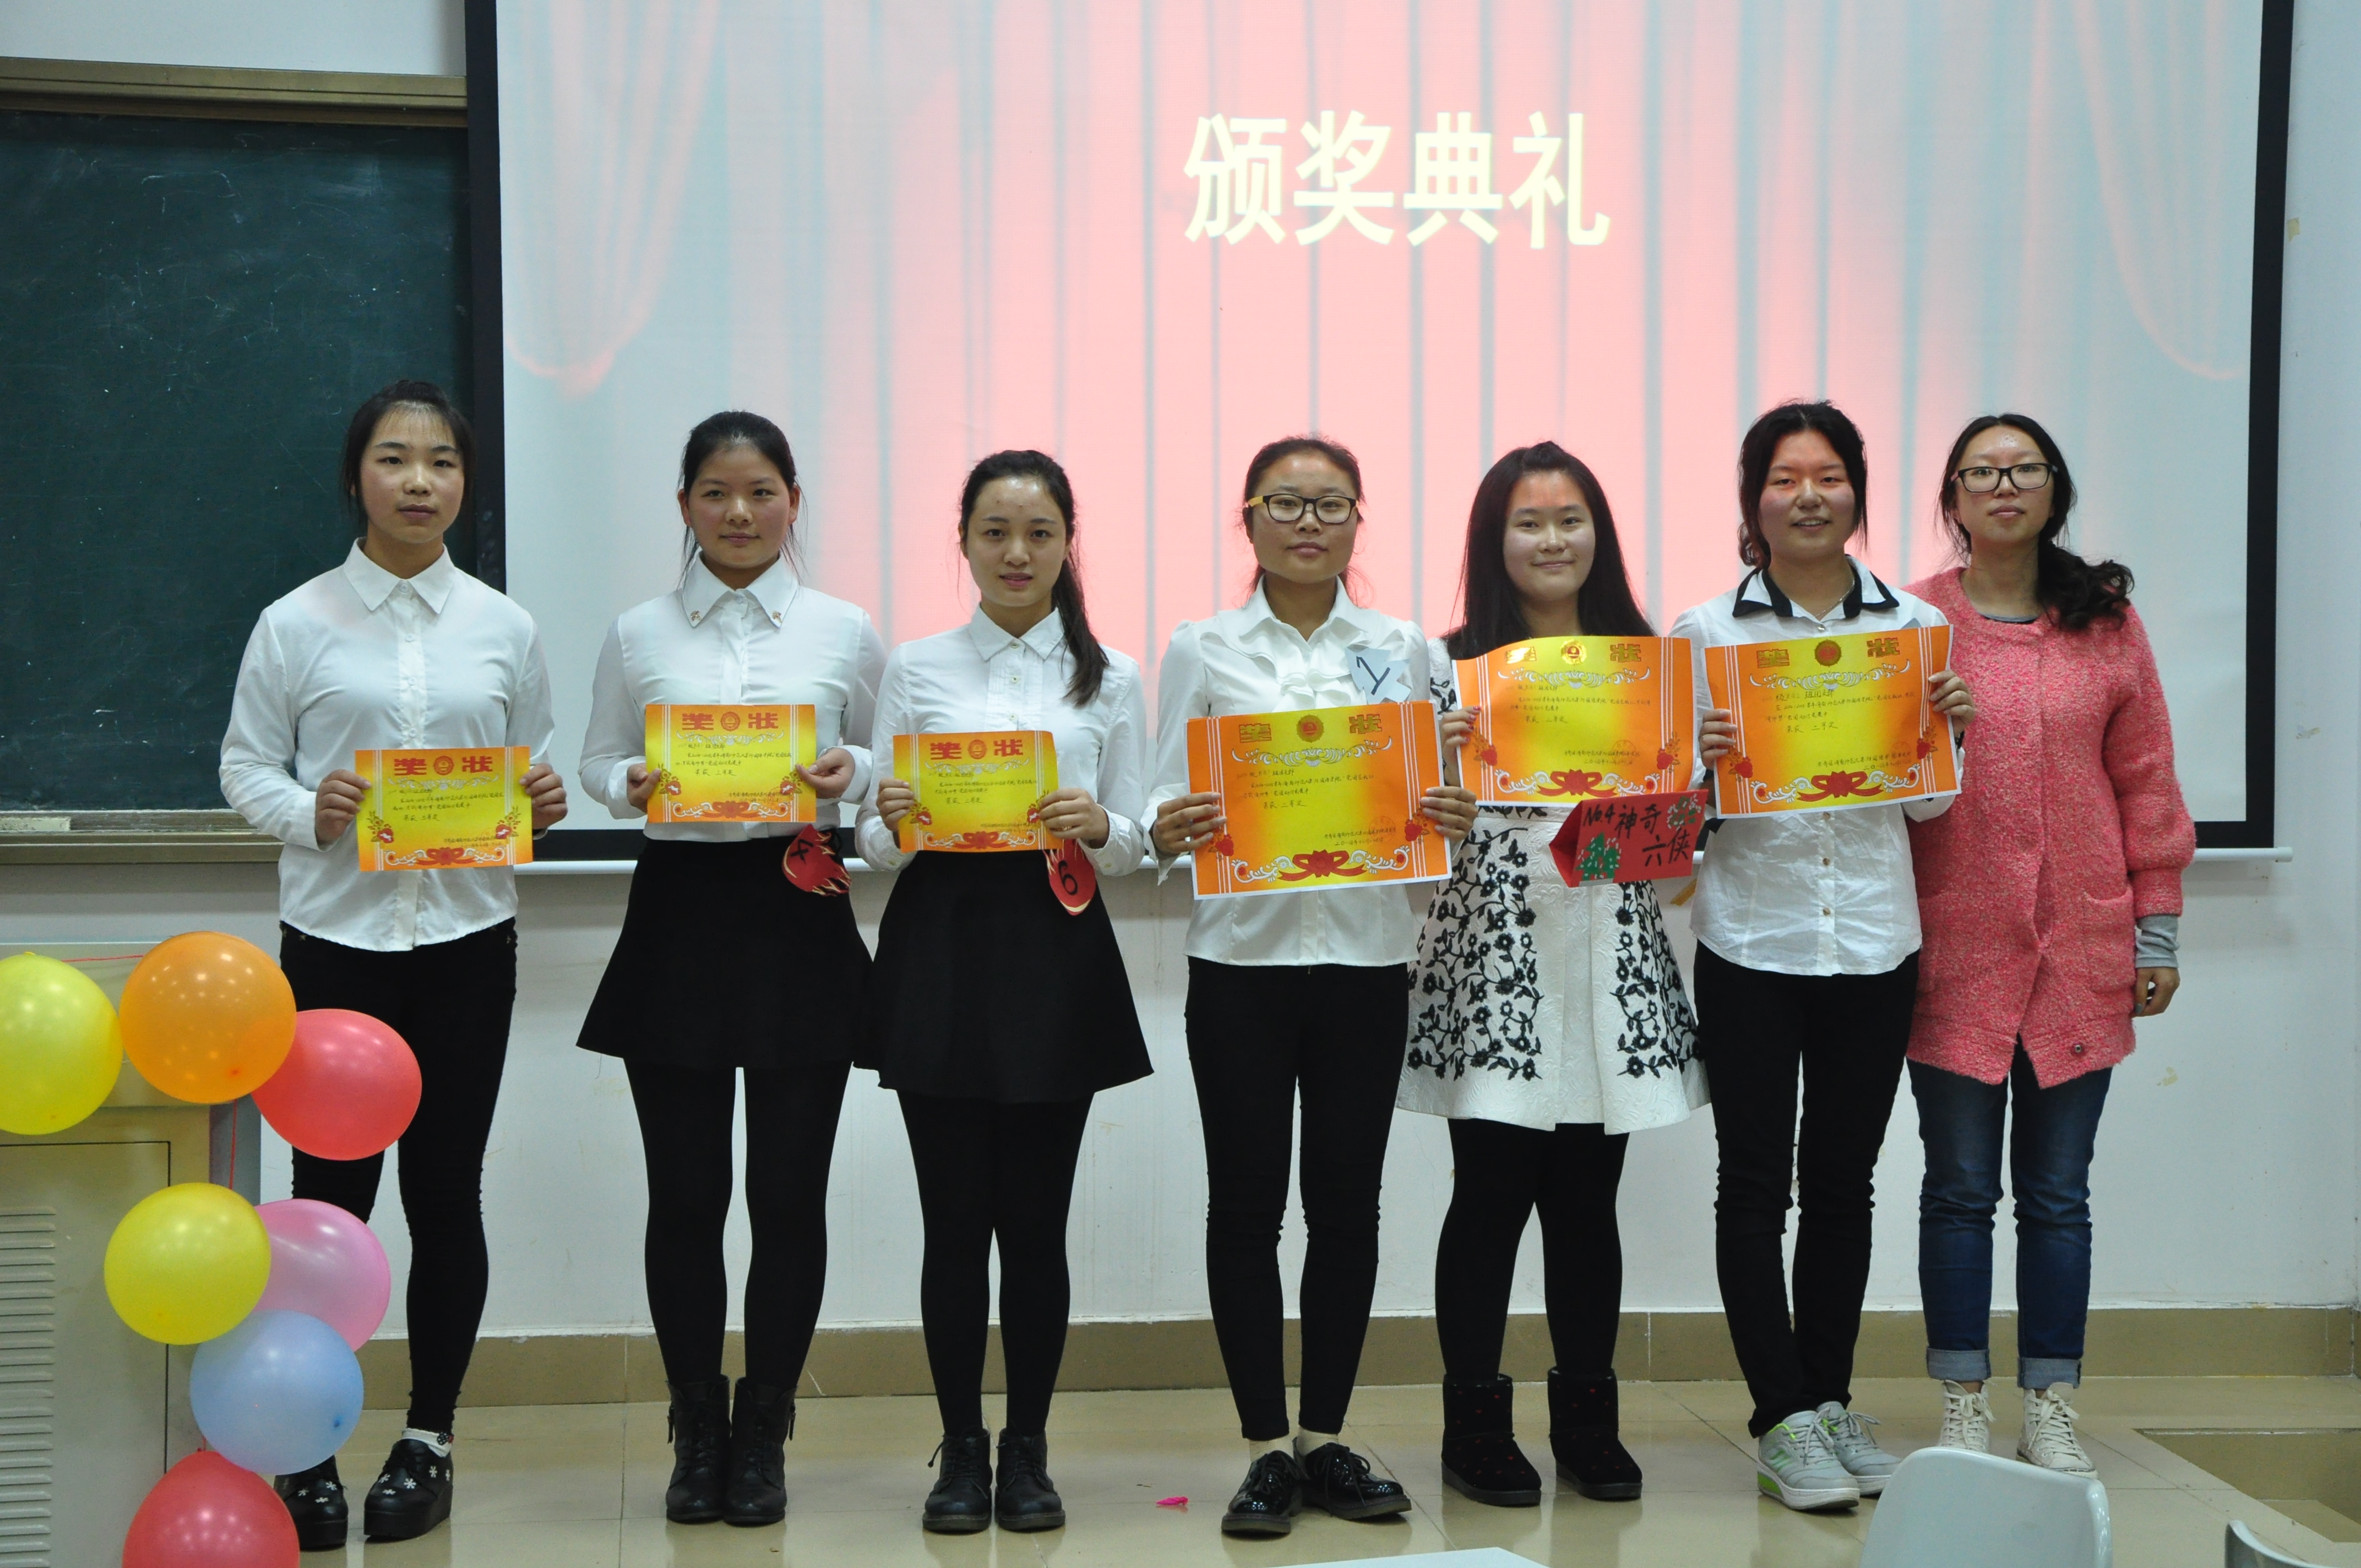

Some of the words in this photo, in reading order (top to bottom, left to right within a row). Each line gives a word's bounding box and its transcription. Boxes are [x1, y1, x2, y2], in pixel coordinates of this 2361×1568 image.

[1183, 110, 1611, 249] 颁奖典礼
[1058, 859, 1079, 896] 6
